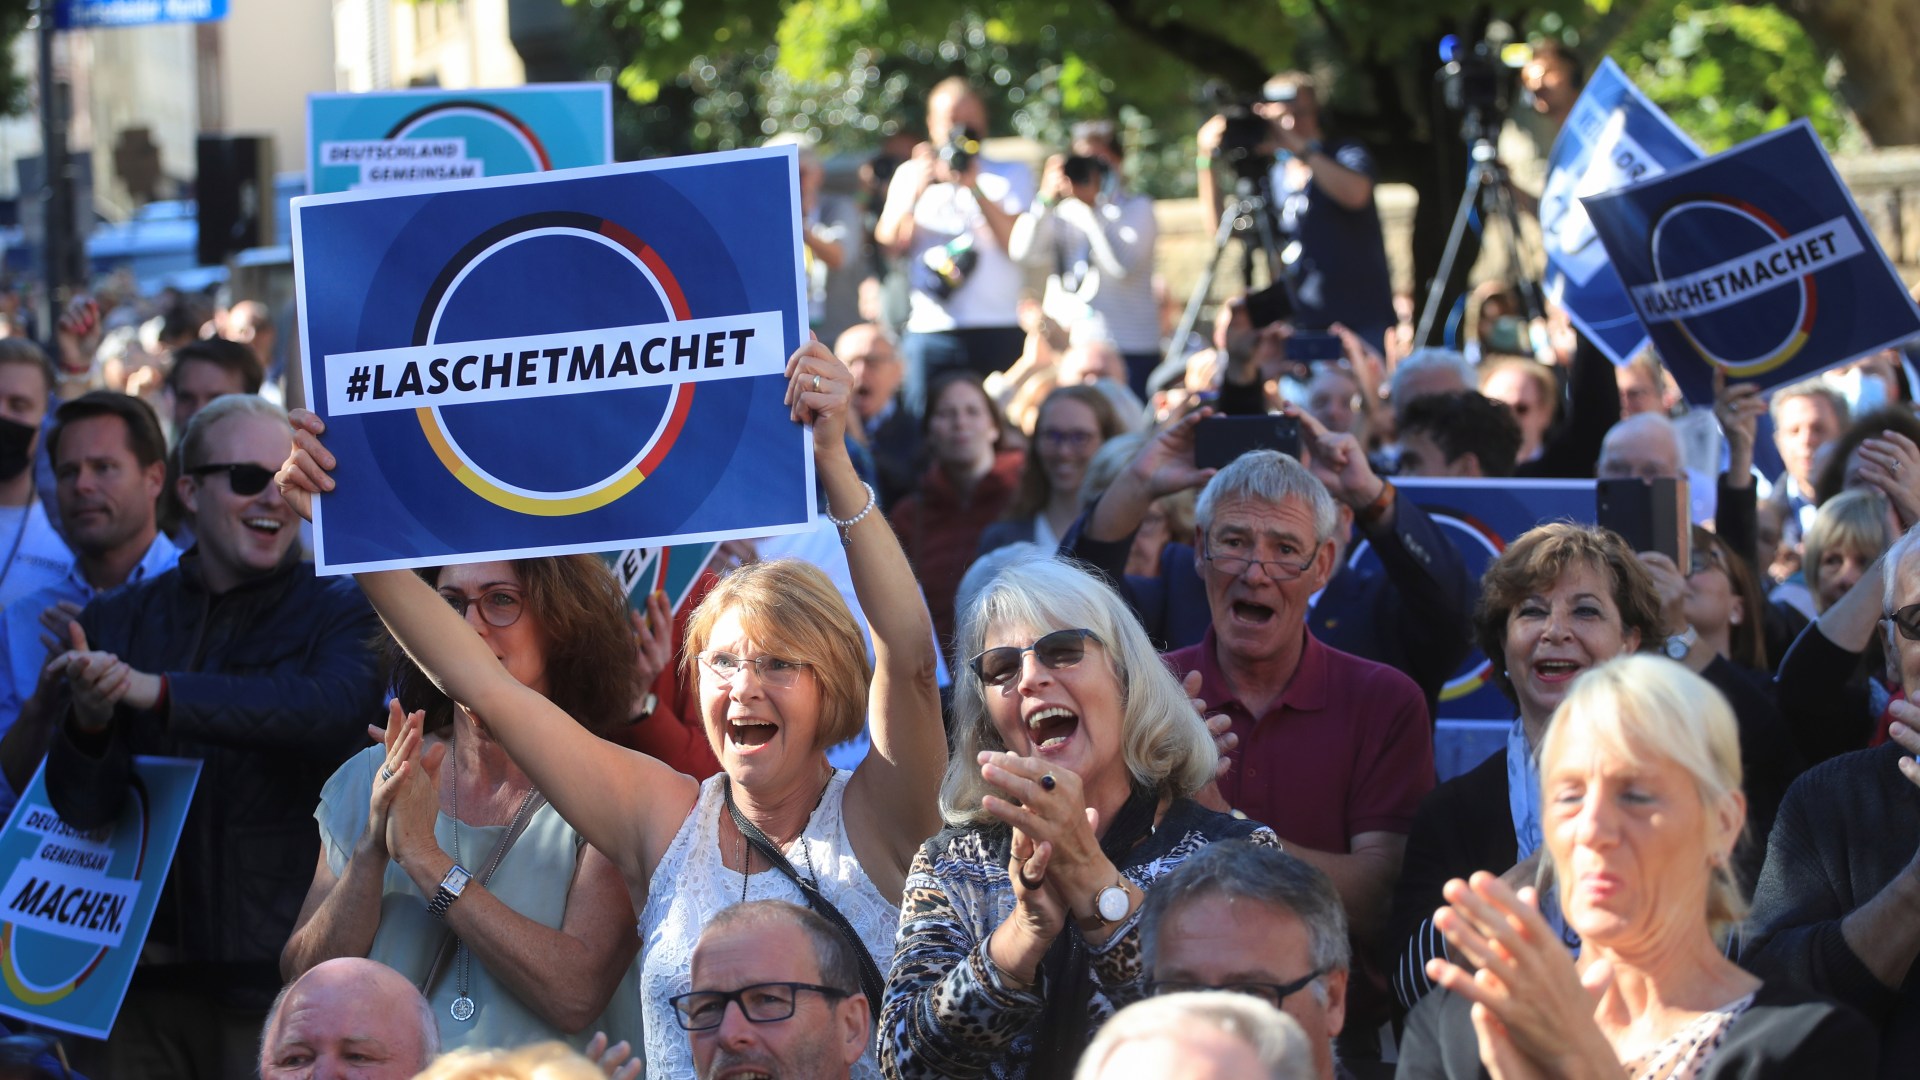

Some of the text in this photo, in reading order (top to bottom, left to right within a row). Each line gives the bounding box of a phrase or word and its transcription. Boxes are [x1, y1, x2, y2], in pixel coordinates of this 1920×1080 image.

[328, 143, 458, 161] DEUTSCHLAND
[369, 165, 475, 182] GEMEINSAM
[346, 328, 756, 402] #LASCHETMACHET
[9, 876, 127, 934] MACHEN.
